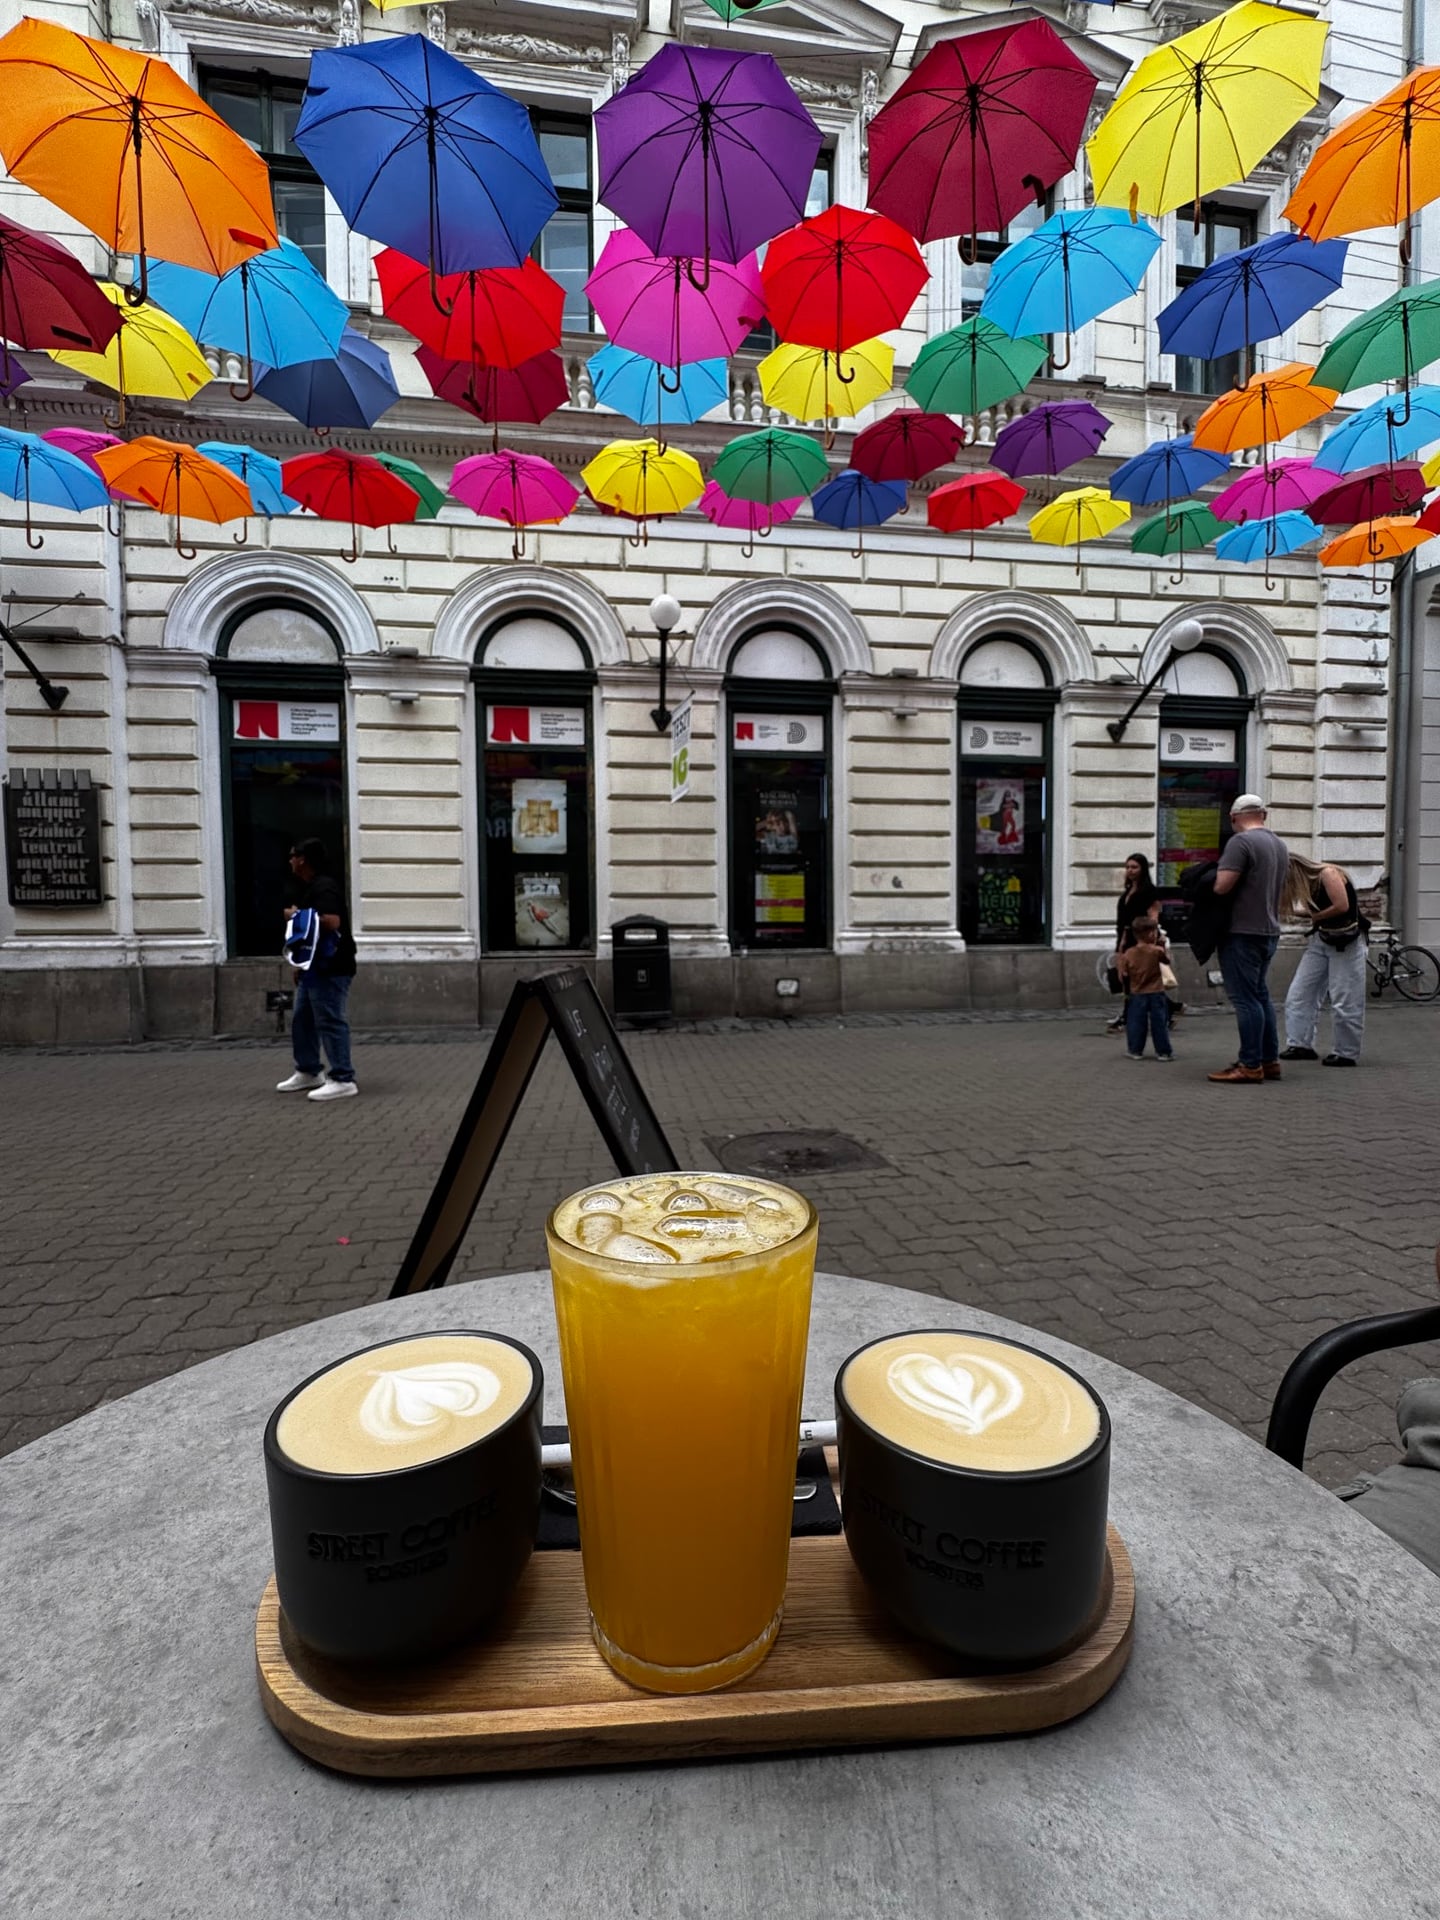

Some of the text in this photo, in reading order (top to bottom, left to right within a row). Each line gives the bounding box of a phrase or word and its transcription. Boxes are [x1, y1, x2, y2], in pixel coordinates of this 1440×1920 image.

[16, 807, 86, 823] magyar
[21, 839, 85, 854] teatrul
[16, 855, 90, 874] maghiar
[21, 870, 88, 885] de stat
[979, 894, 1021, 908] HEIDI
[307, 1488, 500, 1563] STREET COFFEE
[862, 1489, 1047, 1569] STREET COFFEE
[904, 1547, 985, 1591] ROASTERS
